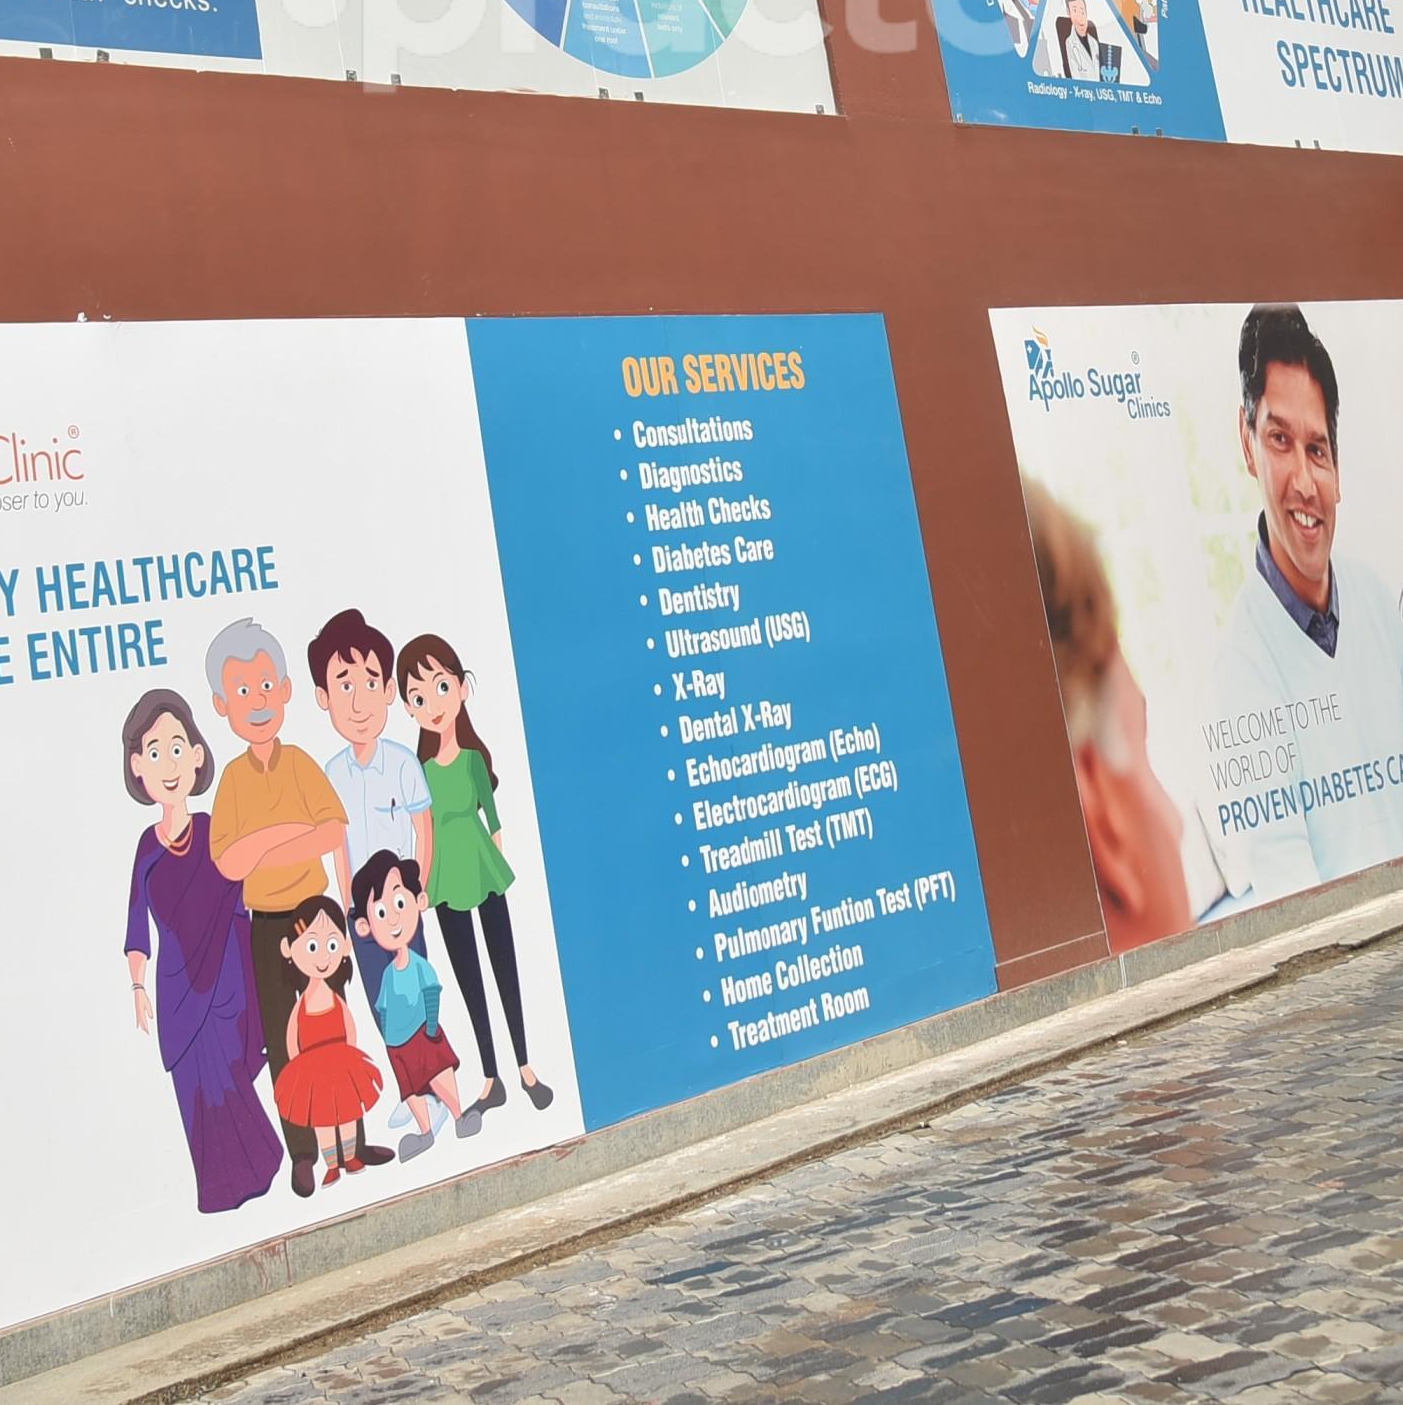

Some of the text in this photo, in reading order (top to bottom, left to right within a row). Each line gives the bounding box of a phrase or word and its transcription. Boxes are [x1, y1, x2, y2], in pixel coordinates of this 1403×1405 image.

[1027, 81, 1068, 100] Radiology
[1096, 88, 1117, 103] USG,
[1116, 89, 1134, 103] TMT
[1143, 91, 1163, 105] Echo
[622, 351, 807, 398] OUR SERVICES
[1029, 368, 1142, 412] Apollo Sugar
[1127, 396, 1172, 419] Clinics
[633, 416, 754, 449] Consultations
[638, 456, 744, 493] Diagnostics
[35, 490, 49, 509] to
[54, 490, 89, 513] you.
[36, 545, 279, 614] HEALTHCARE
[658, 581, 741, 616] Dentistry
[26, 619, 168, 682] ENTIRE
[665, 610, 811, 659] Ultrasound (USG)
[672, 669, 726, 701] X-Ray
[1202, 693, 1342, 752] WELCOME TO THE
[685, 722, 882, 788] Echocardiogram (Echo)
[1210, 742, 1297, 792] WORLD OF
[692, 760, 898, 831] Electrocardiogram (ECG)
[1218, 784, 1298, 837] PROVEN
[1299, 760, 1385, 812] DIABETES
[708, 870, 808, 918] Audiometry
[714, 869, 956, 963] Pulmonary Funtion Test (PFT)
[728, 985, 871, 1051] Treatment Room
